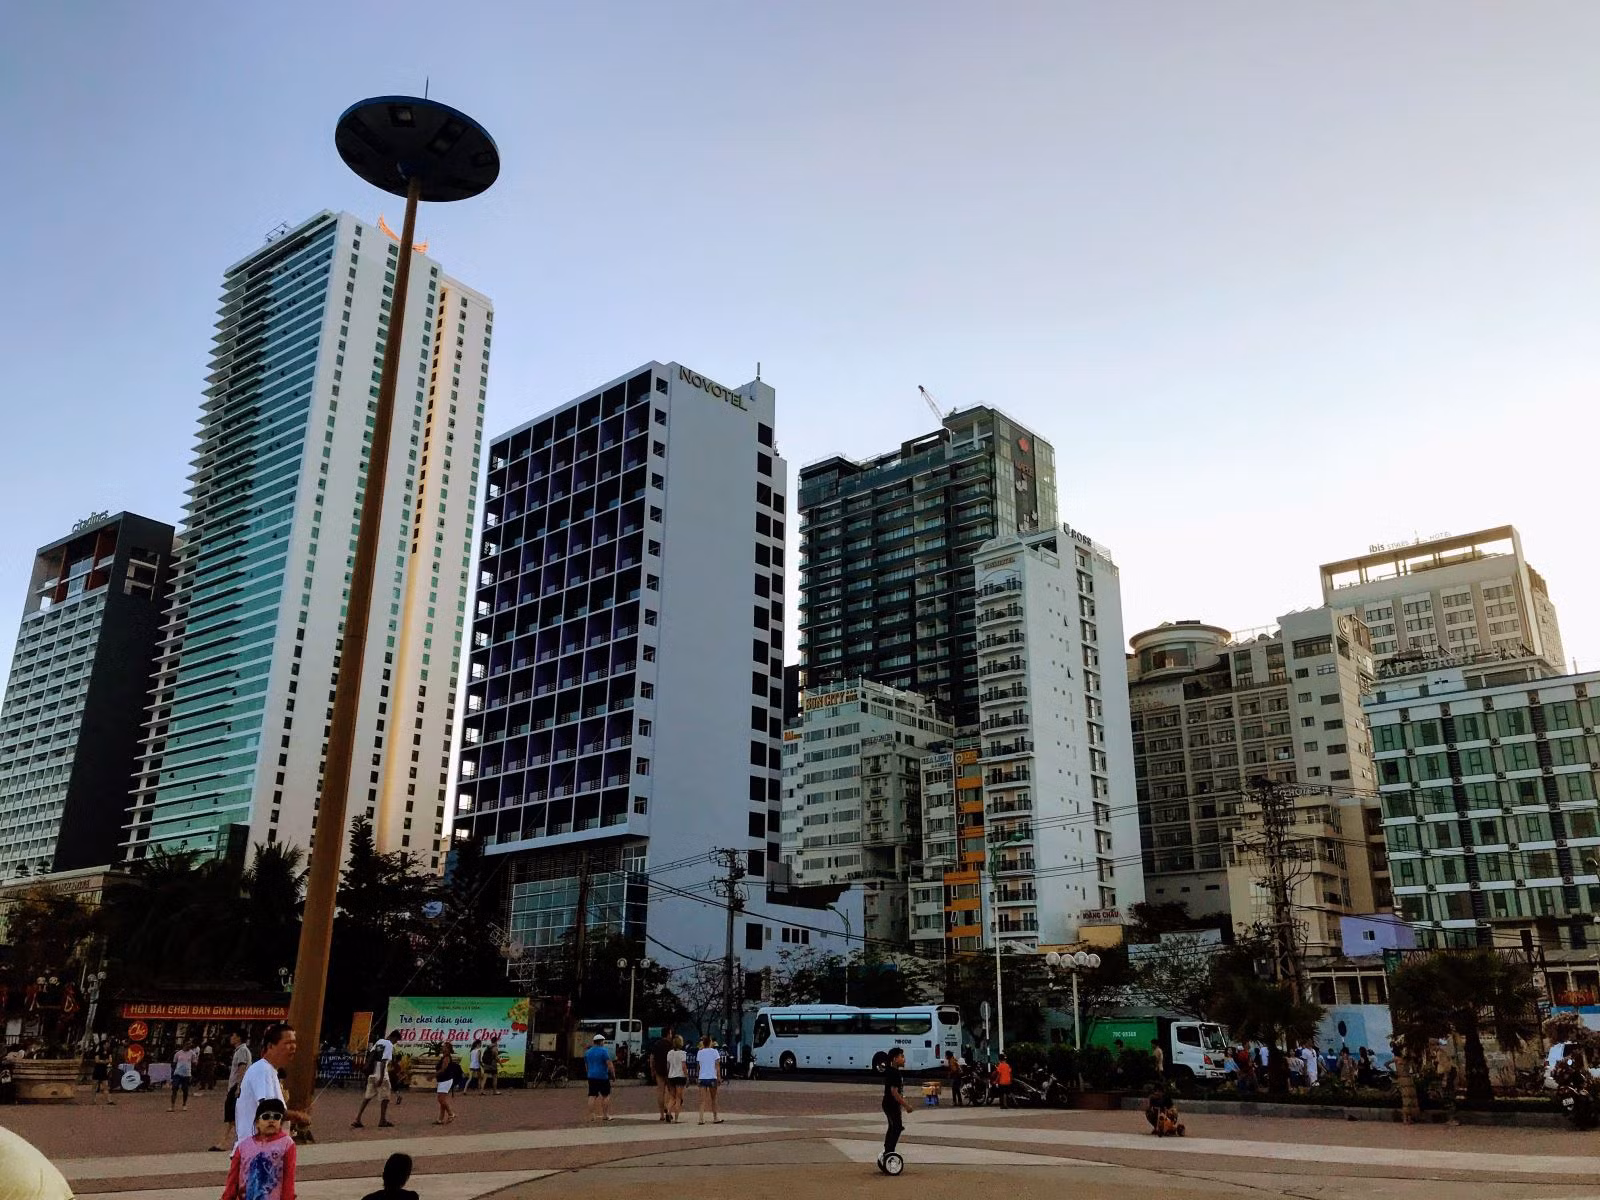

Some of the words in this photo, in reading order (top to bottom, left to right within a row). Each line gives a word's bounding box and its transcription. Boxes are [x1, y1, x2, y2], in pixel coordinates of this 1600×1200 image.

[680, 365, 748, 411] NOVOTEL
[1369, 543, 1385, 553] ibis
[1429, 531, 1452, 541] HOTEL
[805, 695, 824, 710] SUN
[825, 692, 846, 706] CITY
[454, 1016, 474, 1026] gian
